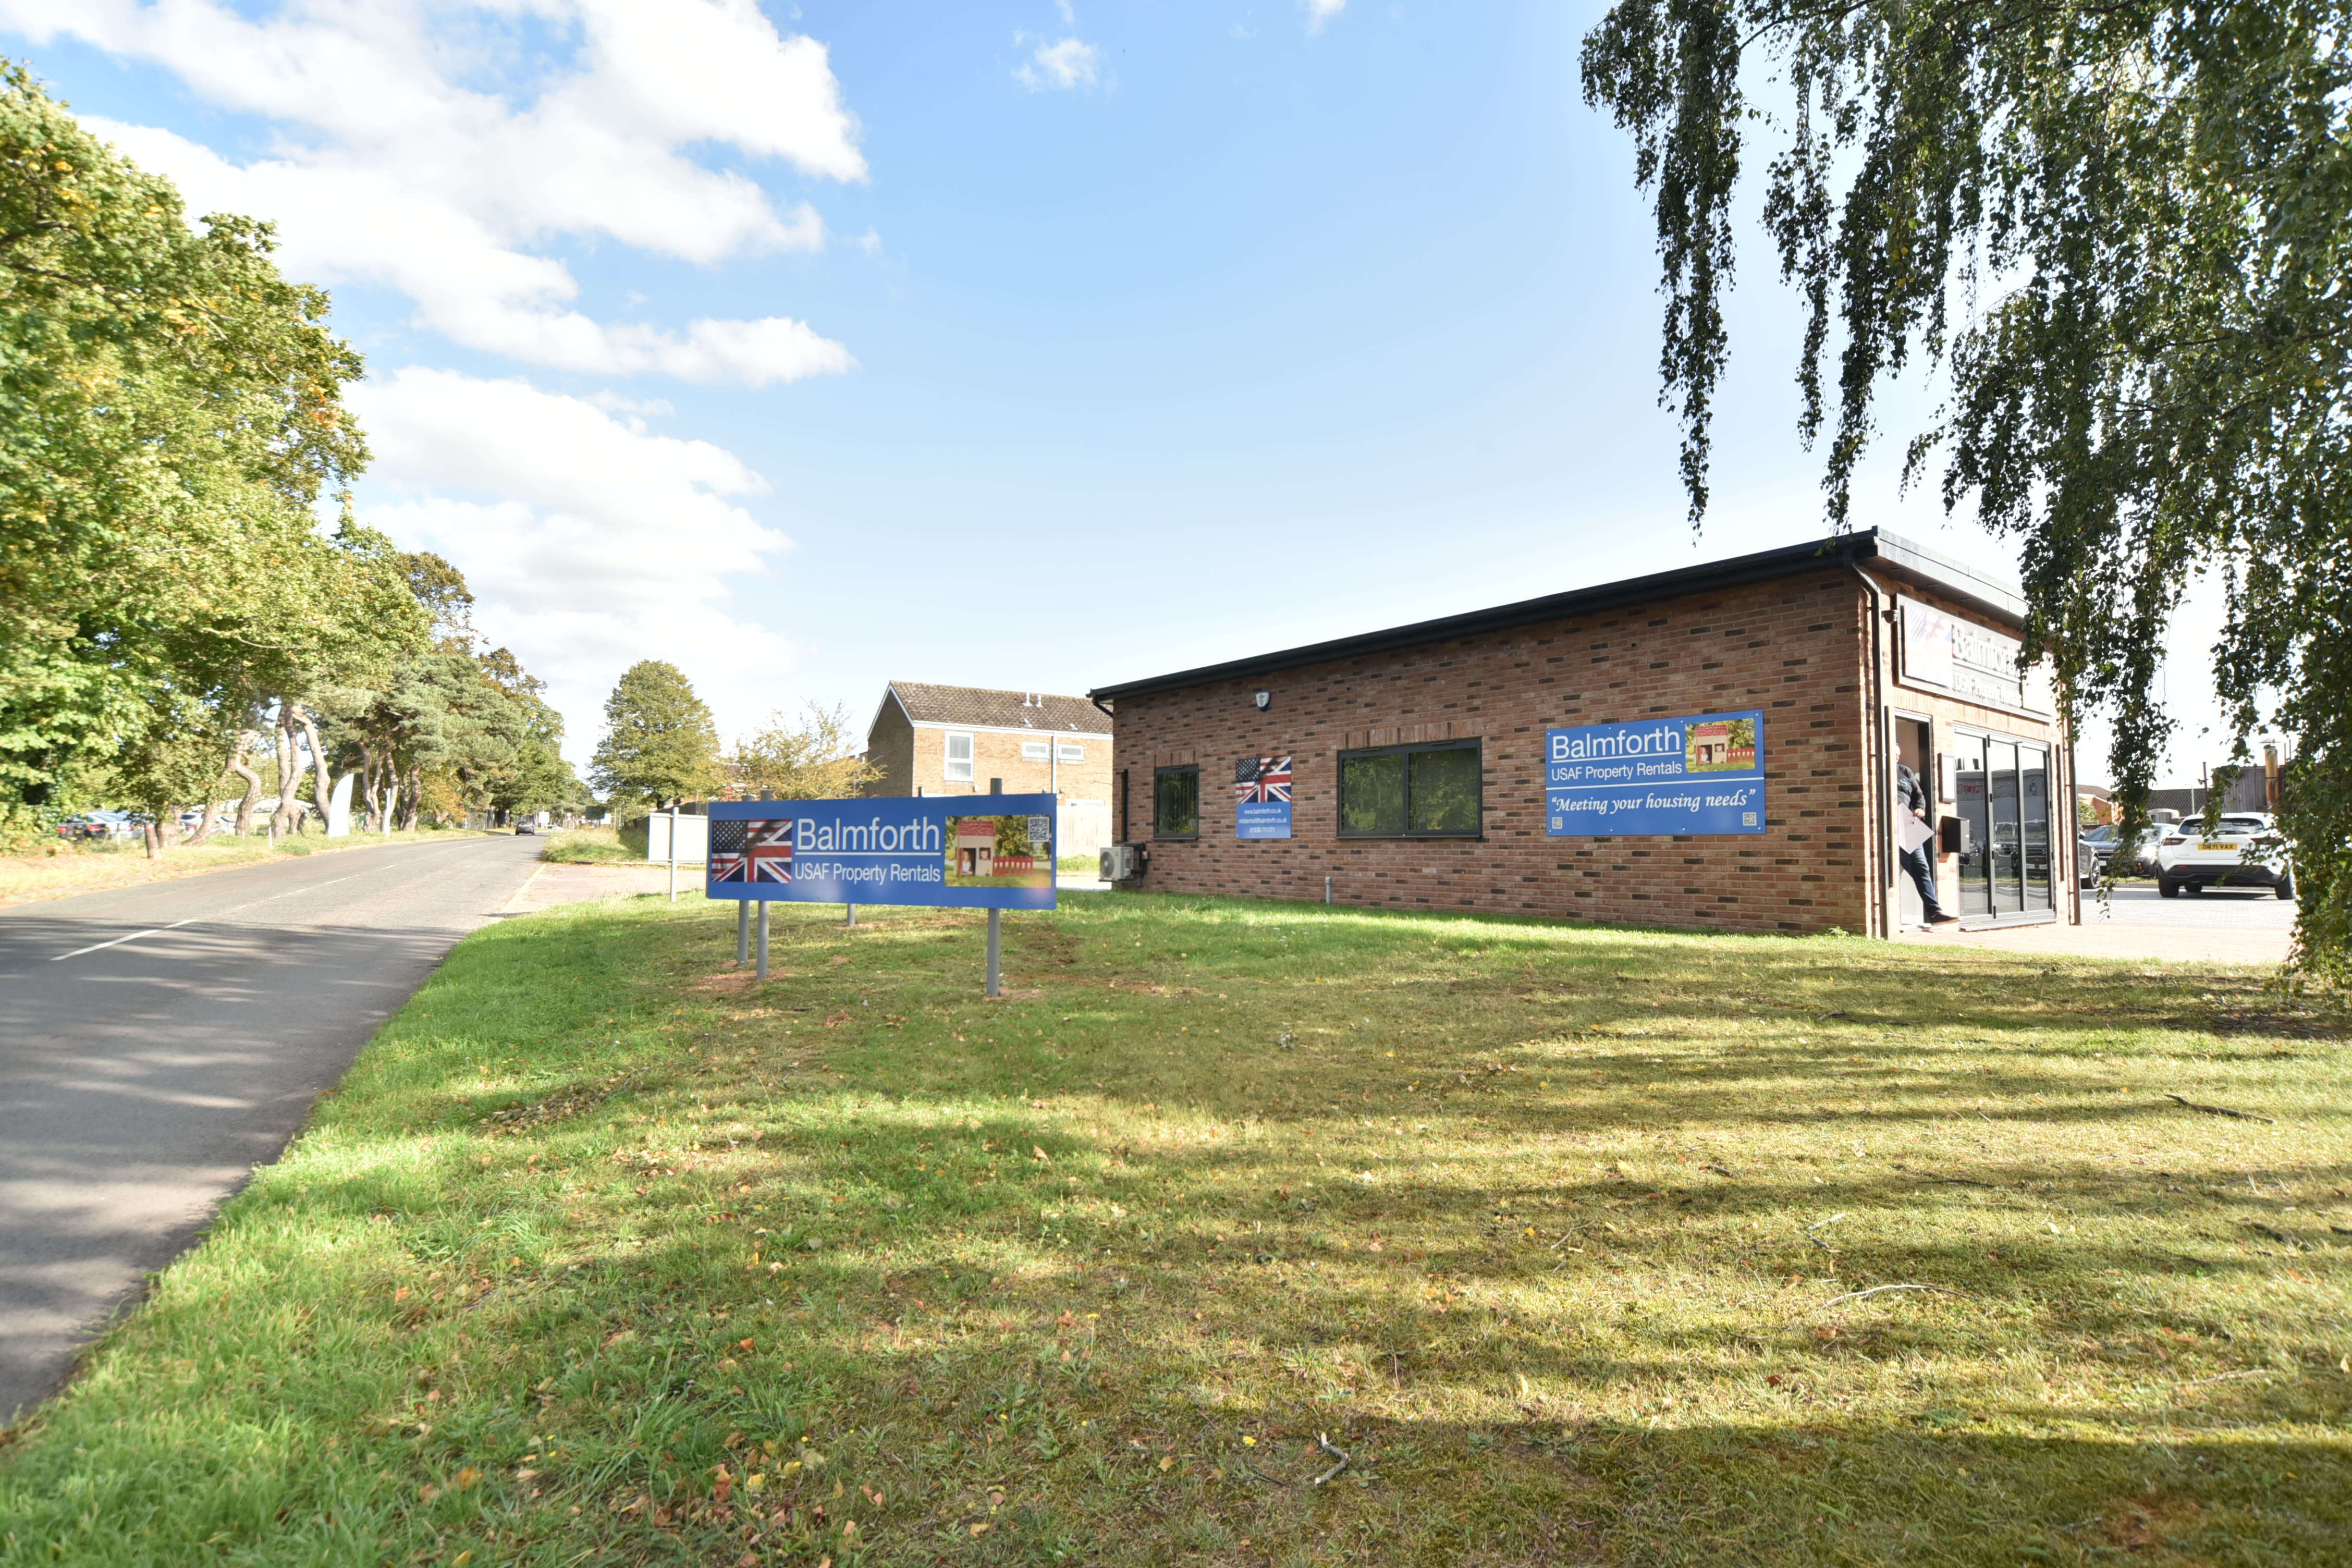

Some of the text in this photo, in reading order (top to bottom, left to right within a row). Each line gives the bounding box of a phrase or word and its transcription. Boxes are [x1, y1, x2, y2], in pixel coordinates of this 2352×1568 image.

[1552, 725, 1680, 760] Balmforth
[1551, 761, 1683, 781] USAF Property Rentals
[1609, 798, 1643, 815] your
[1645, 792, 1701, 812] housing
[797, 816, 940, 851] Balmforth
[795, 863, 941, 885] USAF Property Rentals
